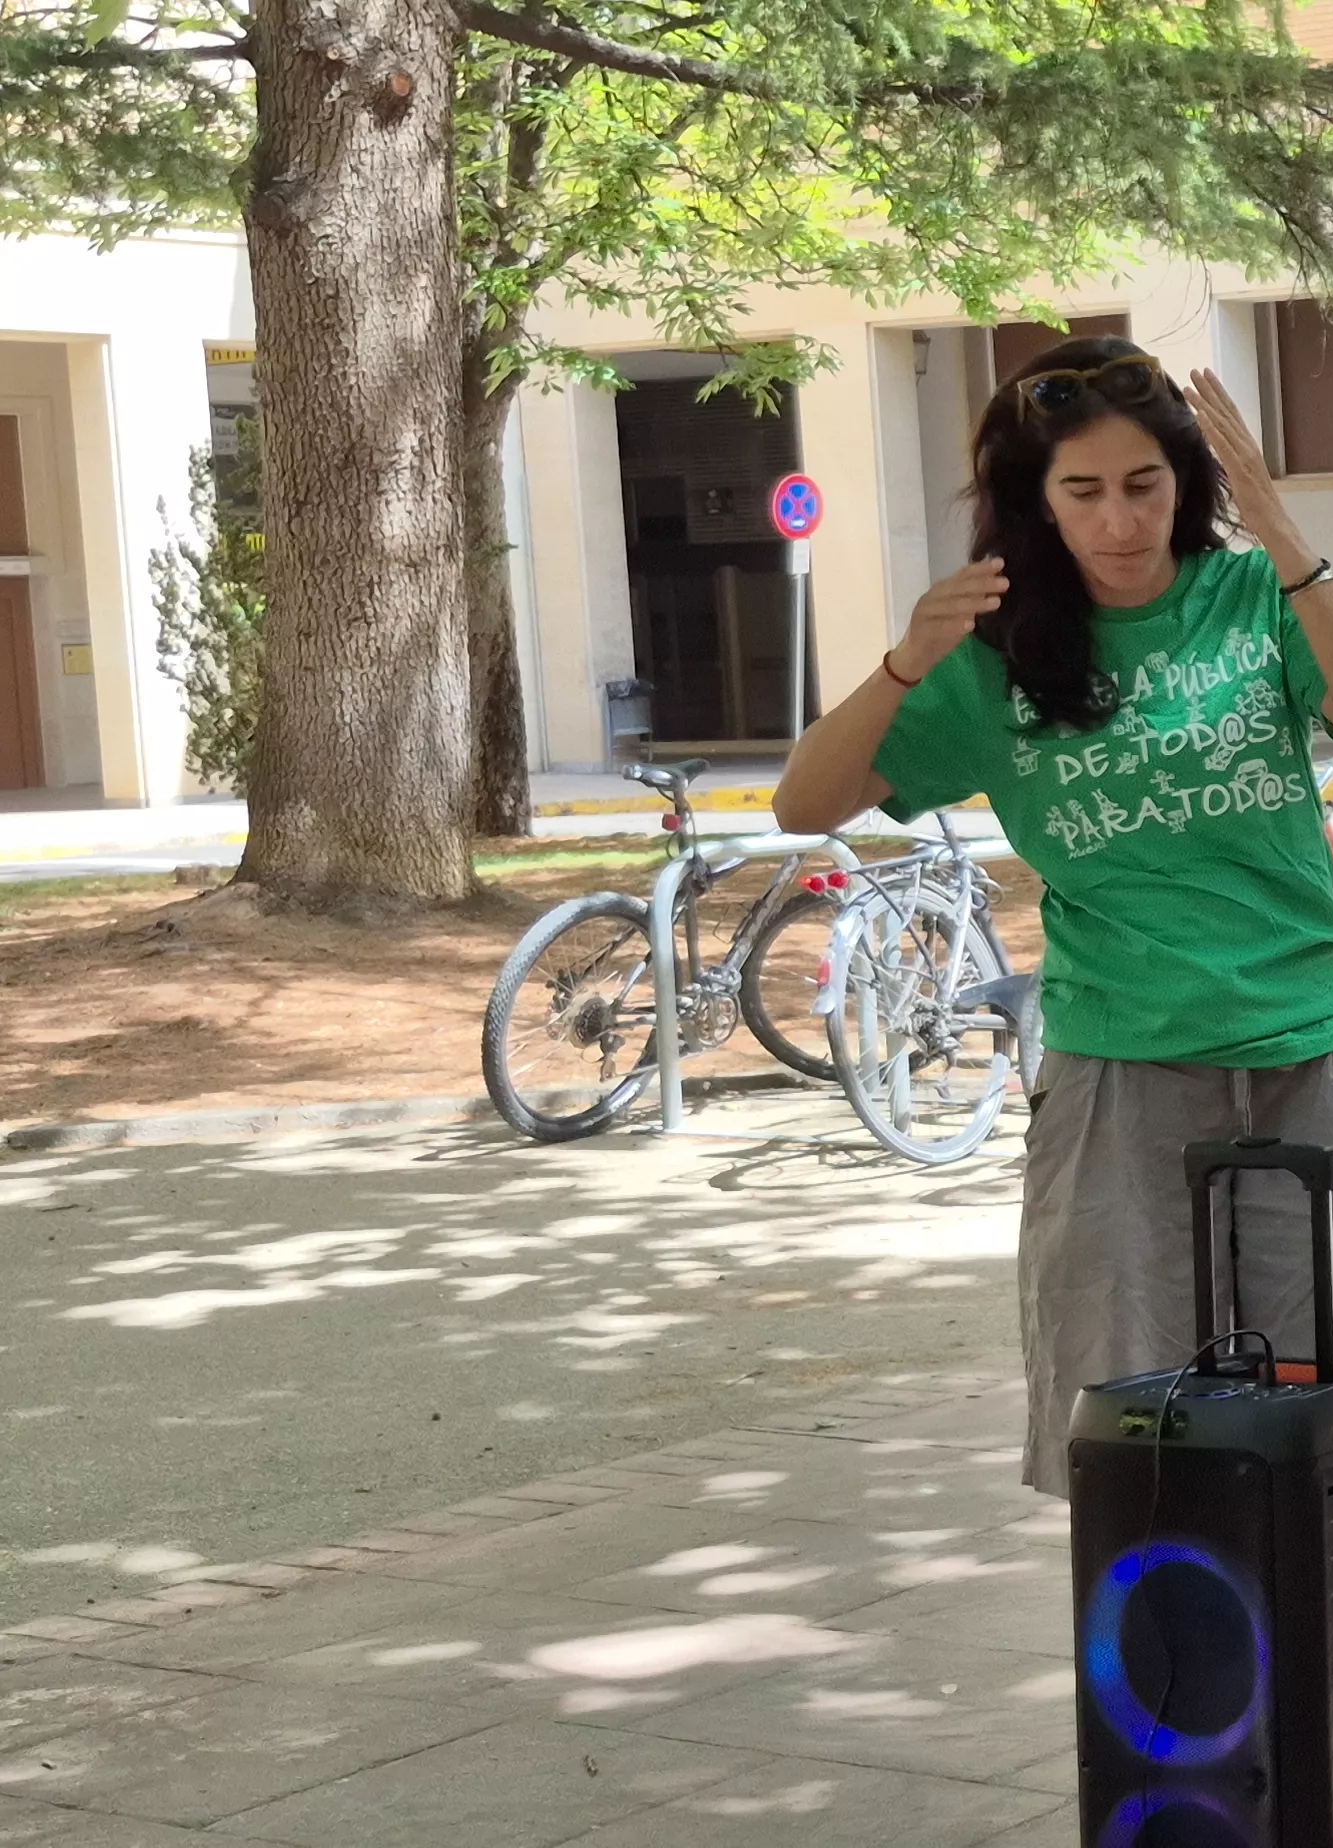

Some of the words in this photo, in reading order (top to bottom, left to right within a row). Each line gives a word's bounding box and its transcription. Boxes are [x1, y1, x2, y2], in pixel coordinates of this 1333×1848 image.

[1054, 742, 1110, 786] DE
[1130, 710, 1278, 764] TOD@S
[1060, 796, 1167, 850] PARA
[1172, 773, 1307, 820] TOD@S
